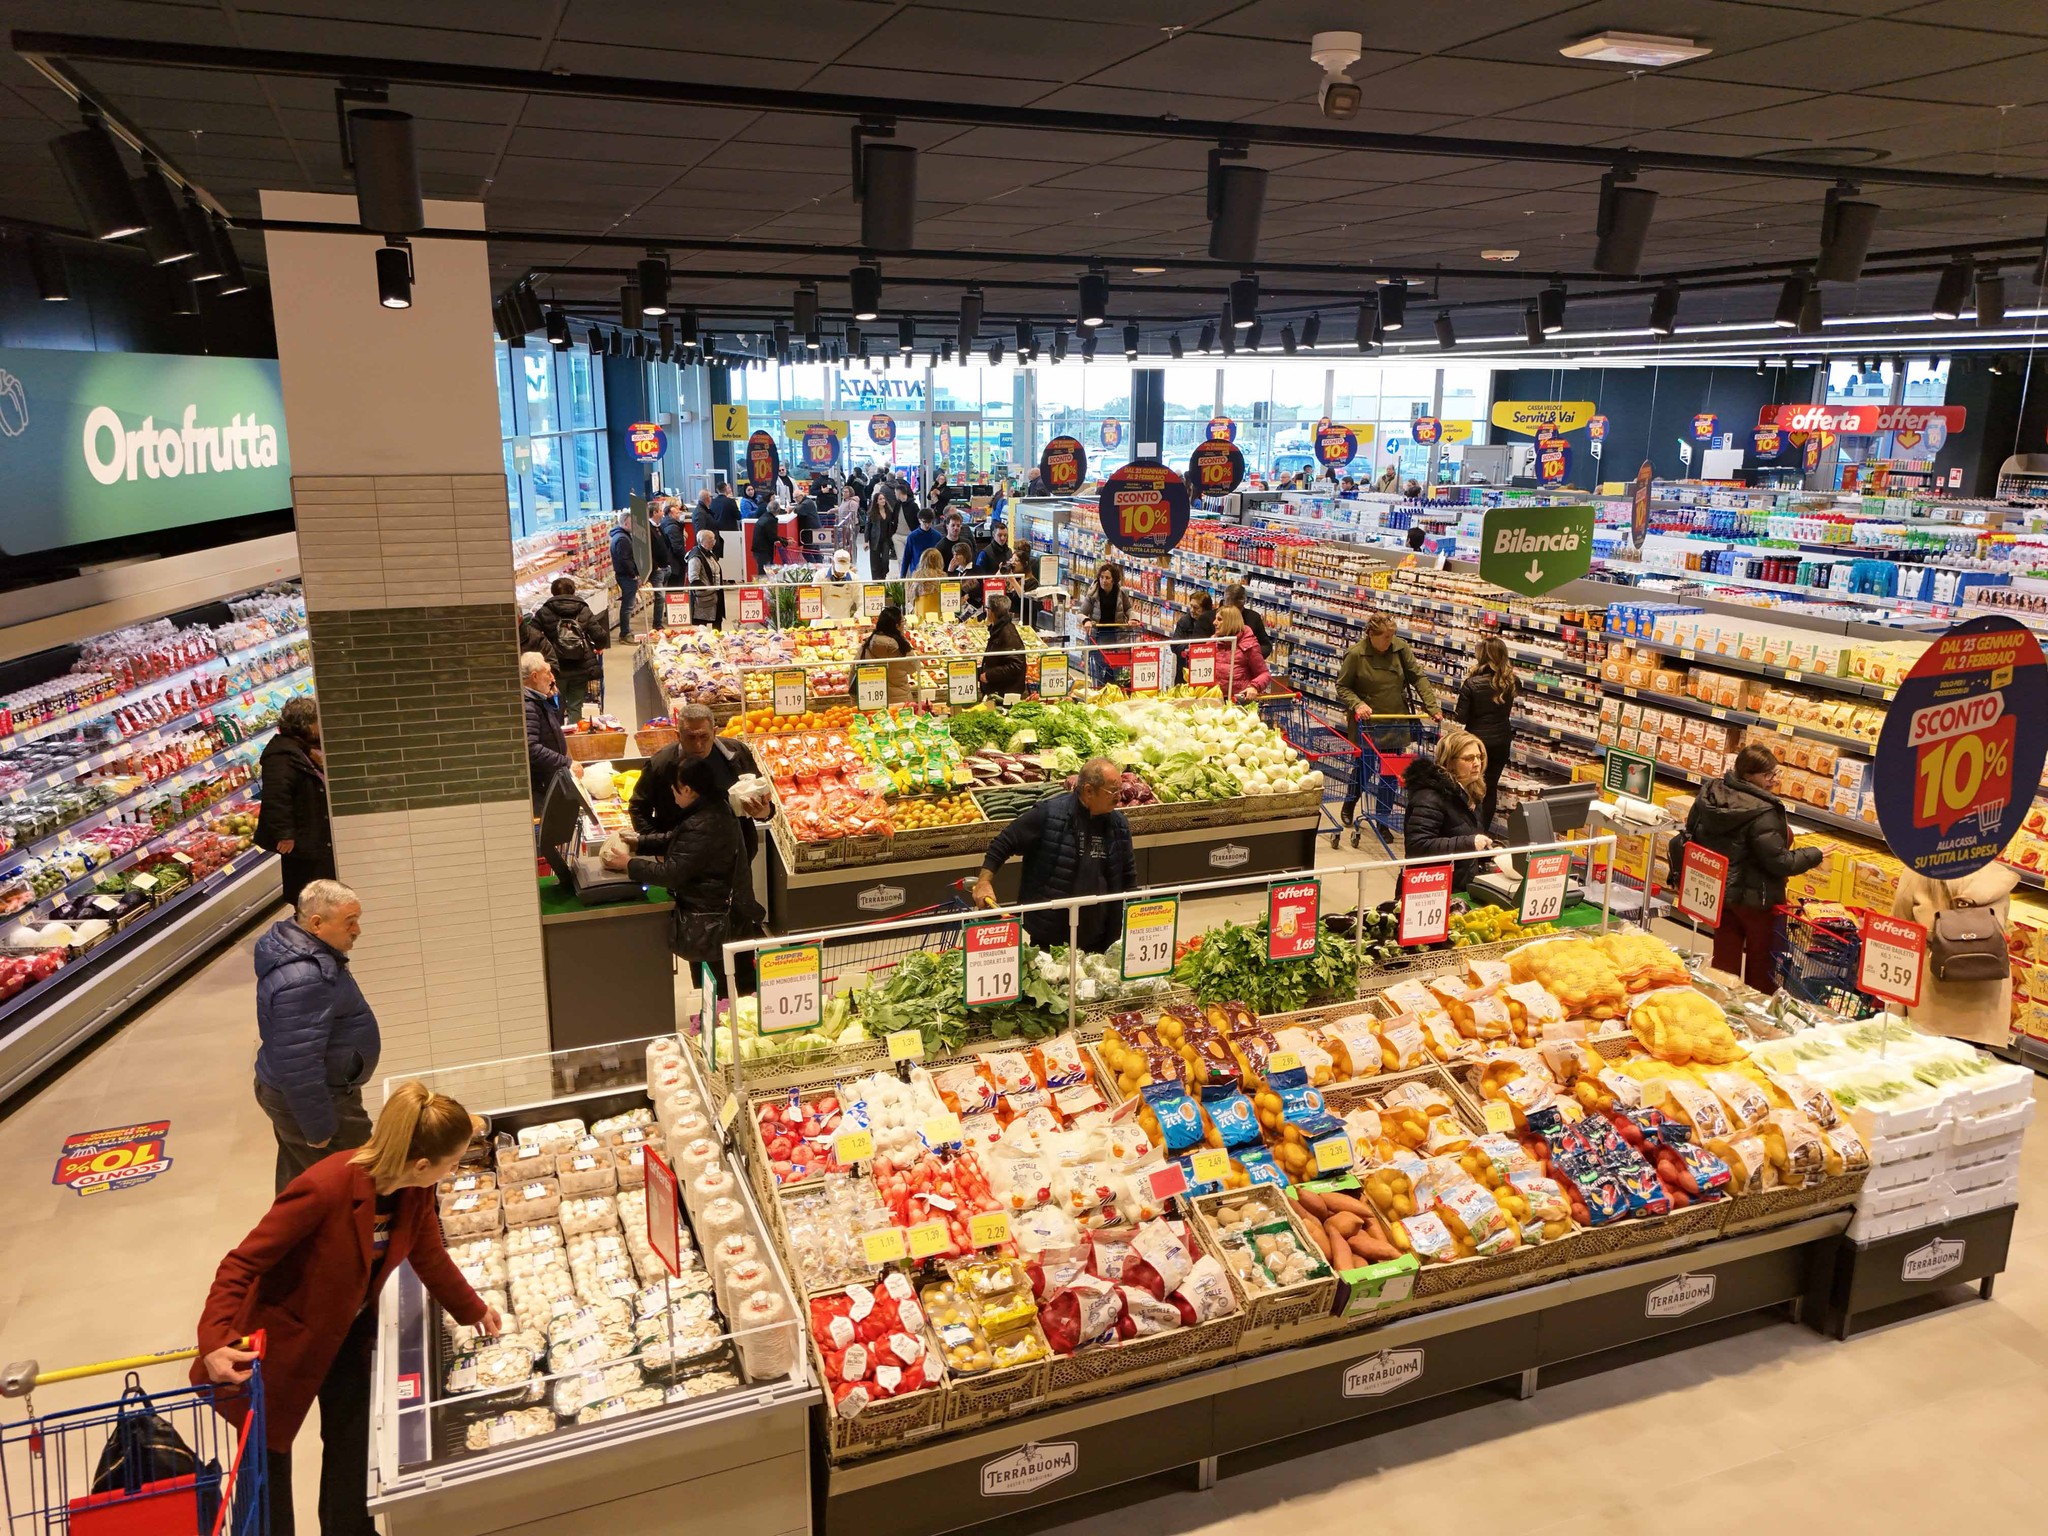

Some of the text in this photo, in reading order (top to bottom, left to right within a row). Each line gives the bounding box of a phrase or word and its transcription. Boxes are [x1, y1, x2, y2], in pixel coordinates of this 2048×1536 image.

[1513, 411, 1548, 423] Serviti
[1559, 411, 1575, 422] Vai
[1791, 407, 1861, 431] offerta
[83, 404, 279, 485] Ortofrutta
[1322, 438, 1344, 446] SCONTO
[1757, 439, 1779, 451] 10%
[1049, 454, 1073, 464] SCONTO
[1199, 457, 1226, 465] SCONTO
[1323, 446, 1347, 459] 10%
[1051, 463, 1077, 482] 10%
[1202, 465, 1232, 482] 10%
[1117, 492, 1159, 503] SCONTO
[1121, 505, 1168, 534] 10%
[1493, 526, 1580, 554] Bilancia
[1192, 646, 1214, 654] offerta
[1939, 638, 1961, 655] DAL
[1976, 633, 2025, 651] GENNAIO
[1942, 650, 2016, 671] AL 2 FEBBRAIO
[1914, 696, 1998, 740] SCONTO
[1920, 734, 2009, 819] 10%
[1936, 835, 1978, 851] ALLA CASSA
[1536, 854, 1564, 869] prezzi
[1690, 852, 1721, 870] offerta
[1914, 855, 1928, 869] SU
[1928, 851, 1957, 867] TUTTA
[1956, 849, 1970, 863] LA
[1969, 843, 1998, 861] SPESA
[1410, 871, 1445, 884] offerta
[1537, 864, 1560, 874] fermi
[860, 892, 903, 906] TERRABUONA
[1277, 886, 1315, 900] offerta
[976, 922, 1011, 939] prezzi
[1872, 919, 1917, 941] offerta
[978, 932, 1009, 946] fermi
[774, 951, 803, 961] SUPER
[978, 949, 1007, 958] TERRABUONA
[65, 1143, 155, 1176] 10%
[78, 1162, 162, 1185] SCONTO
[1906, 1249, 1960, 1274] TERRABUONA
[1650, 1283, 1710, 1311] TERRABUONA
[1348, 1358, 1418, 1390] TERRABUONA
[987, 1452, 1072, 1489] TERRABUONA
